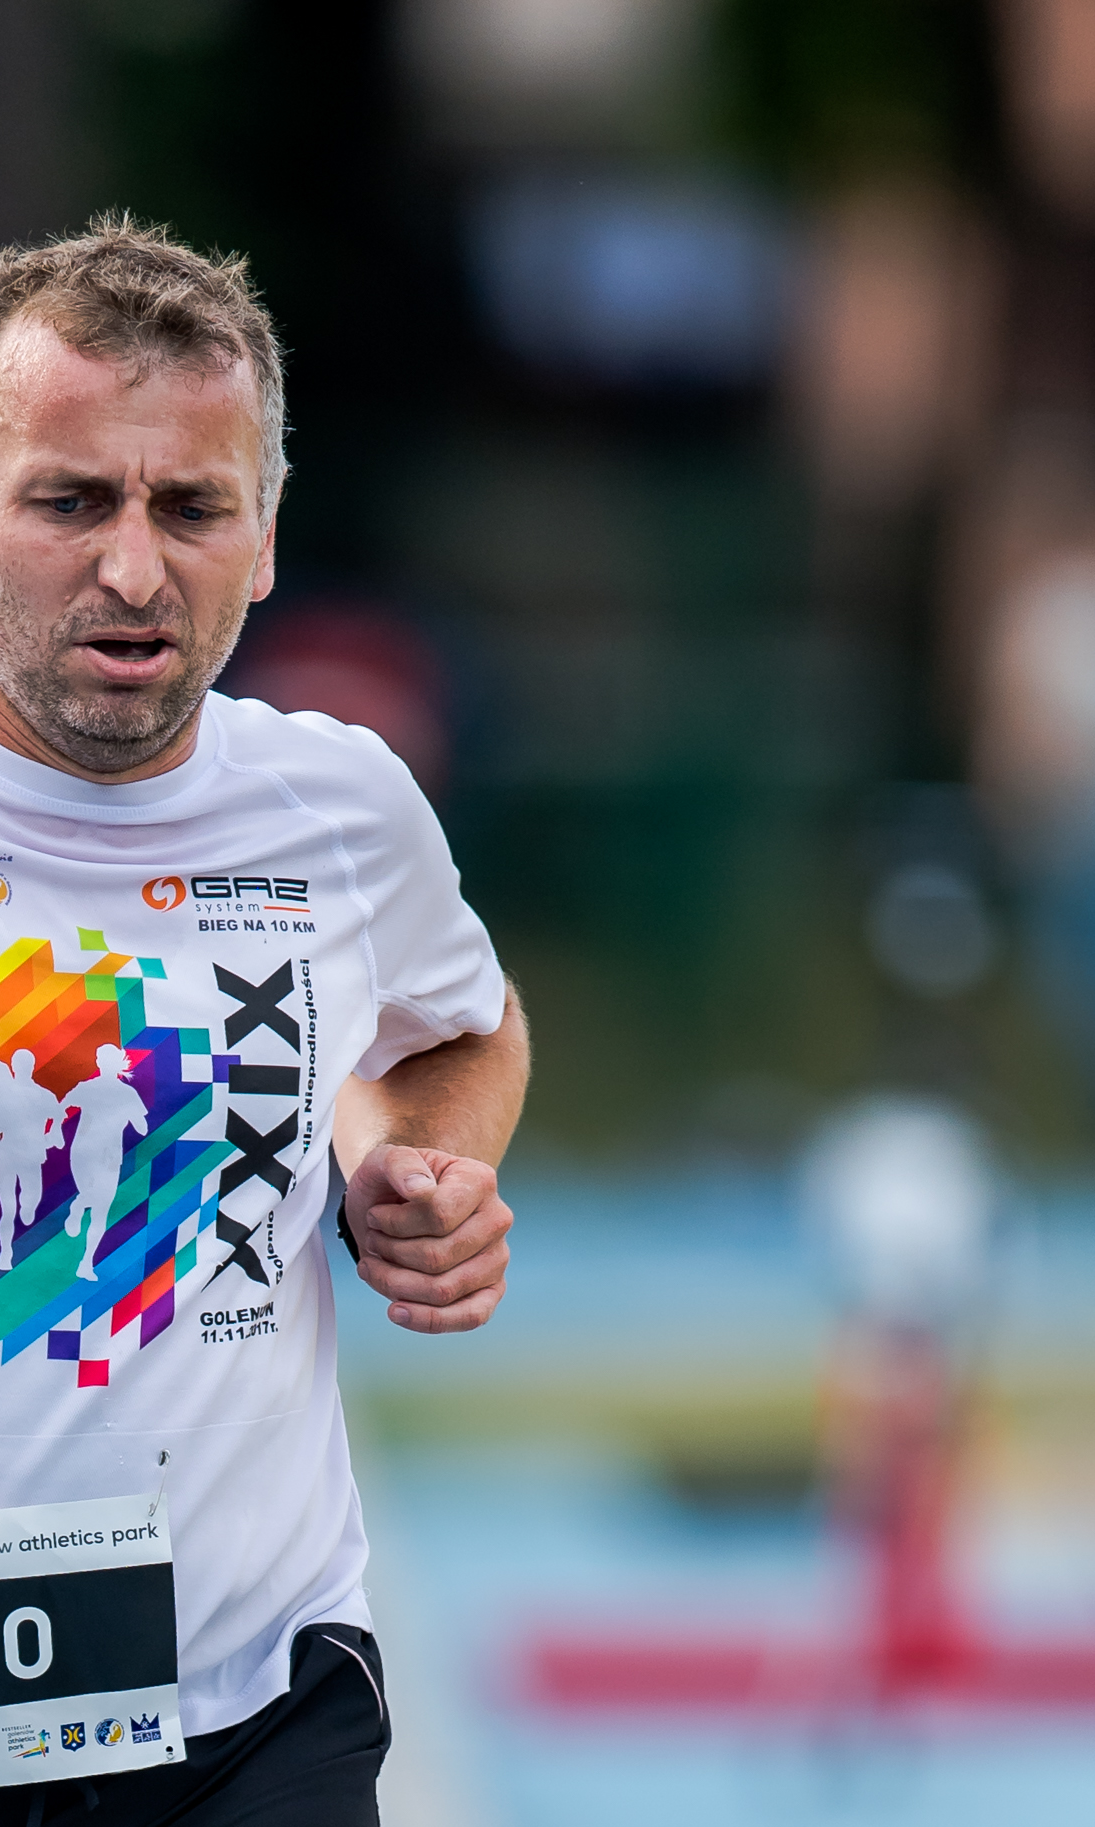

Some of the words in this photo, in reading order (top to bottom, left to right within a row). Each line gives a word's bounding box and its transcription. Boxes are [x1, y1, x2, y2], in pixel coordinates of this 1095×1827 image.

[196, 901, 260, 914] system
[198, 919, 239, 932] BIEG
[243, 919, 266, 932] NA
[270, 920, 289, 932] 10
[293, 921, 317, 933] KM
[201, 957, 302, 1293] XXIX
[18, 1529, 105, 1553] athletics
[111, 1521, 160, 1547] park
[8, 1736, 36, 1744] athletics
[8, 1744, 24, 1752] park
